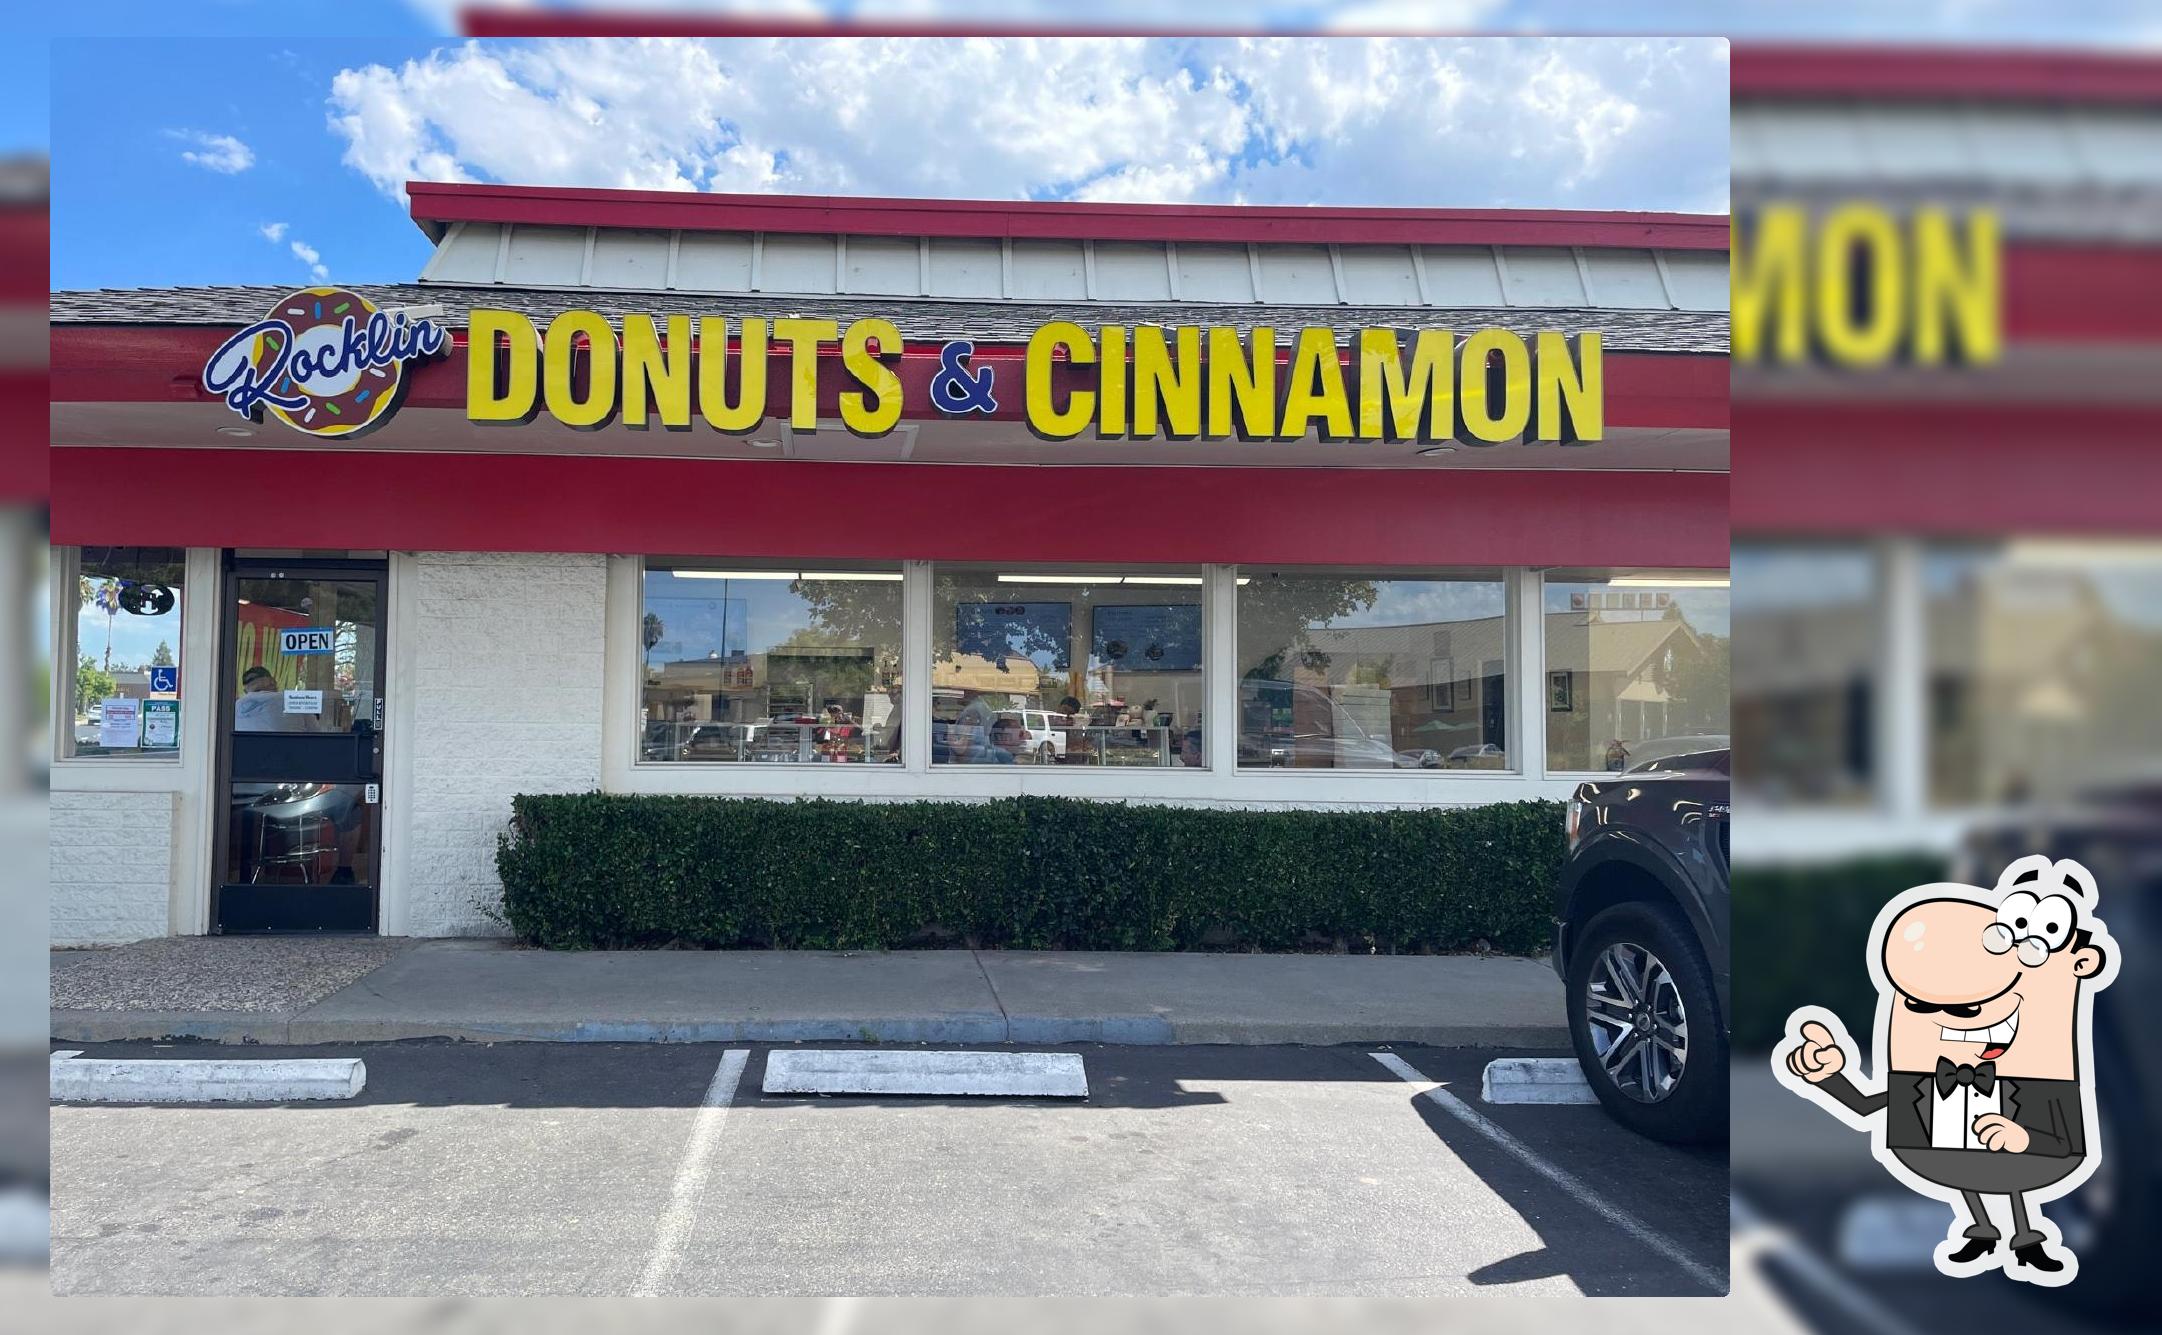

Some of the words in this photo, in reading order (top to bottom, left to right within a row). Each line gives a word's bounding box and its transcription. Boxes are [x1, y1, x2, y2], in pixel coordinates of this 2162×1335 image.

[203, 310, 446, 416] Rocklin
[467, 308, 904, 436] DONUTS
[930, 340, 998, 414] &
[1025, 321, 1604, 443] CINNAMON
[285, 633, 329, 650] OPEN
